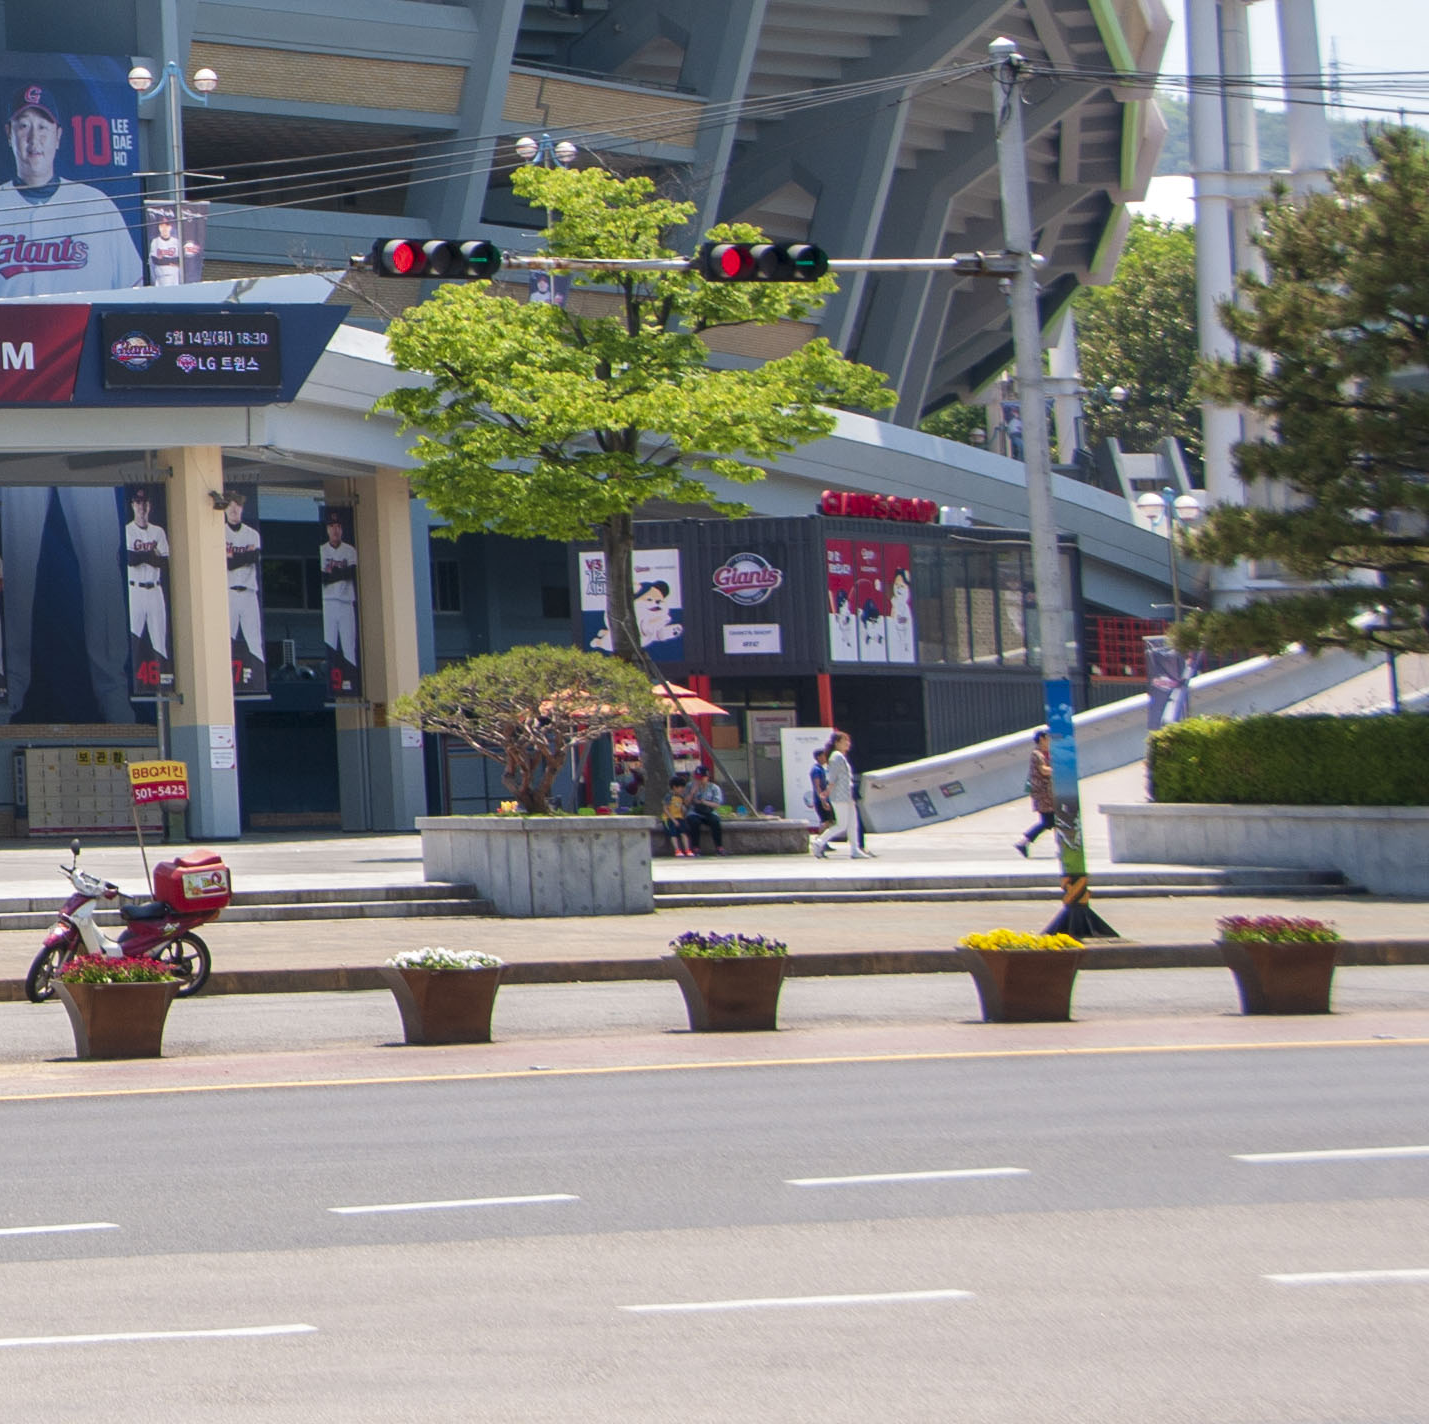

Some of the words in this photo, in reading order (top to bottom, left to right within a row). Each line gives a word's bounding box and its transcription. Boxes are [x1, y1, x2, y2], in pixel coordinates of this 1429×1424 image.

[111, 119, 130, 134] LEE
[71, 115, 112, 166] 10
[112, 135, 133, 150] DAE
[113, 151, 128, 166] HO
[165, 330, 184, 345] 5월
[237, 332, 269, 345] 18:30
[198, 357, 216, 370] LG
[221, 356, 260, 372] 트윈스
[713, 566, 779, 586] Giants
[136, 661, 160, 684] 46
[132, 765, 183, 779] BBQ치킨
[134, 784, 185, 800] 501-5425
